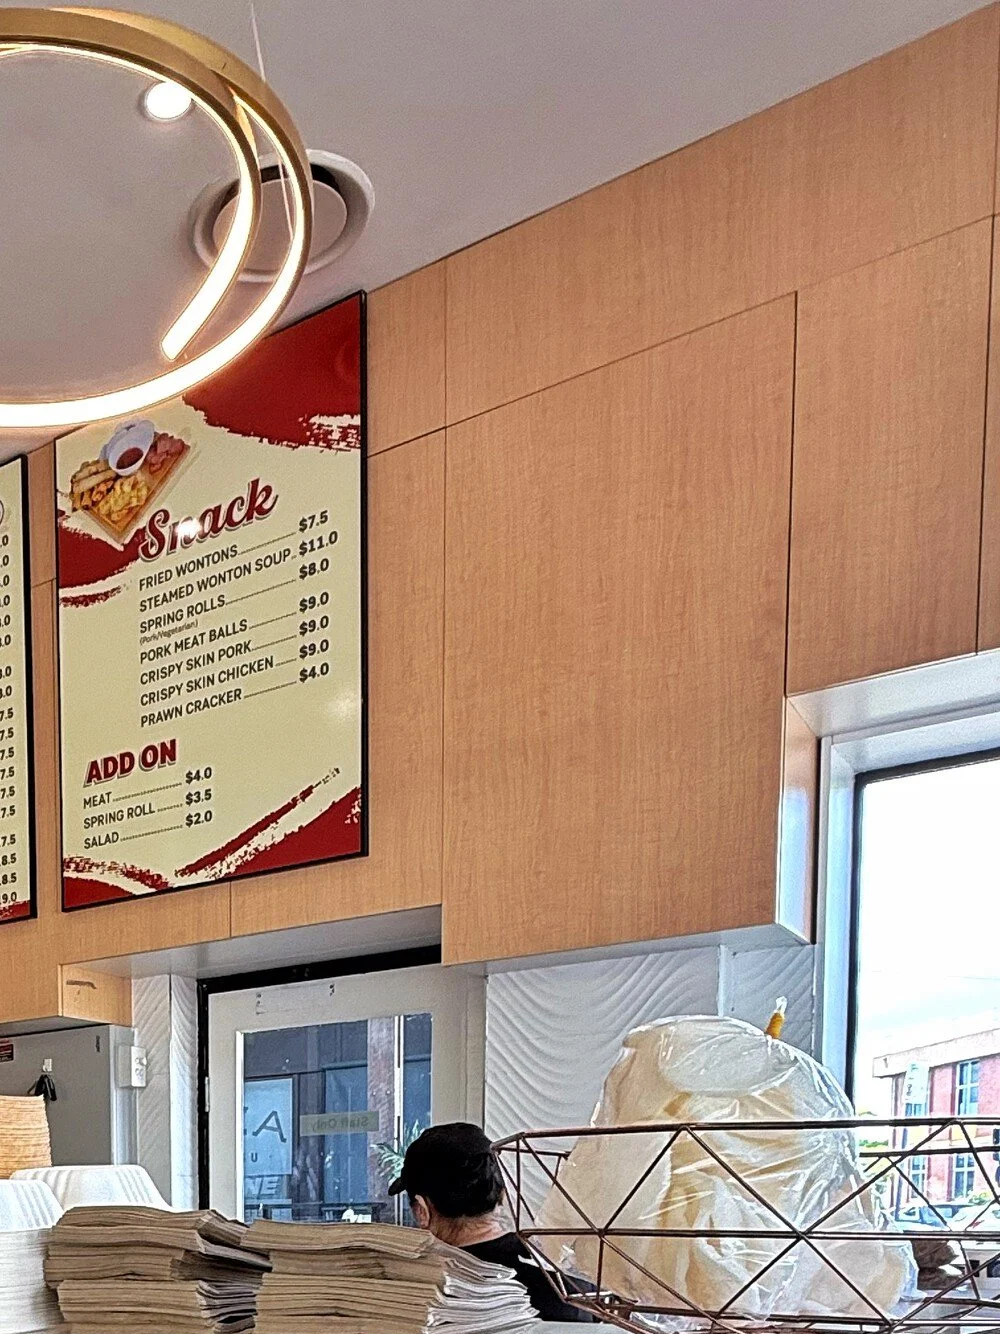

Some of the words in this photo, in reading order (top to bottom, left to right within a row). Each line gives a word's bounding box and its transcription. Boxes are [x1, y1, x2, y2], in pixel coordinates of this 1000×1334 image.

[139, 478, 278, 562] Snack
[139, 568, 172, 591] FRIED
[175, 544, 237, 577] WONTONS
[298, 509, 327, 533] $7.5
[139, 583, 193, 612] STEAMED
[196, 561, 251, 592] WONTON
[254, 547, 290, 571] SOUP
[298, 530, 337, 557] $11.0
[139, 608, 183, 633] SPRING
[186, 594, 225, 618] ROLLS
[298, 557, 329, 580] $8.0
[140, 643, 171, 664] PORK
[174, 631, 206, 653] MEAT
[208, 618, 247, 642] BALLS
[299, 591, 328, 613] $9.0
[140, 682, 183, 706] CRISPY
[185, 673, 214, 693] SKIN
[217, 655, 273, 683] CHICKEN
[299, 638, 329, 659] $9.0
[140, 704, 182, 727] PRAWN
[185, 688, 241, 714] CRACKER
[299, 662, 329, 683] $4.0
[83, 791, 111, 809] MEAT
[185, 766, 211, 784] $4.0
[84, 752, 134, 787] ADD
[139, 739, 177, 771] ON
[83, 809, 124, 829] SPRING
[126, 802, 155, 819] ROLL
[185, 788, 211, 806] $3.5
[83, 831, 119, 849] SALAD
[185, 809, 212, 827] $2.0
